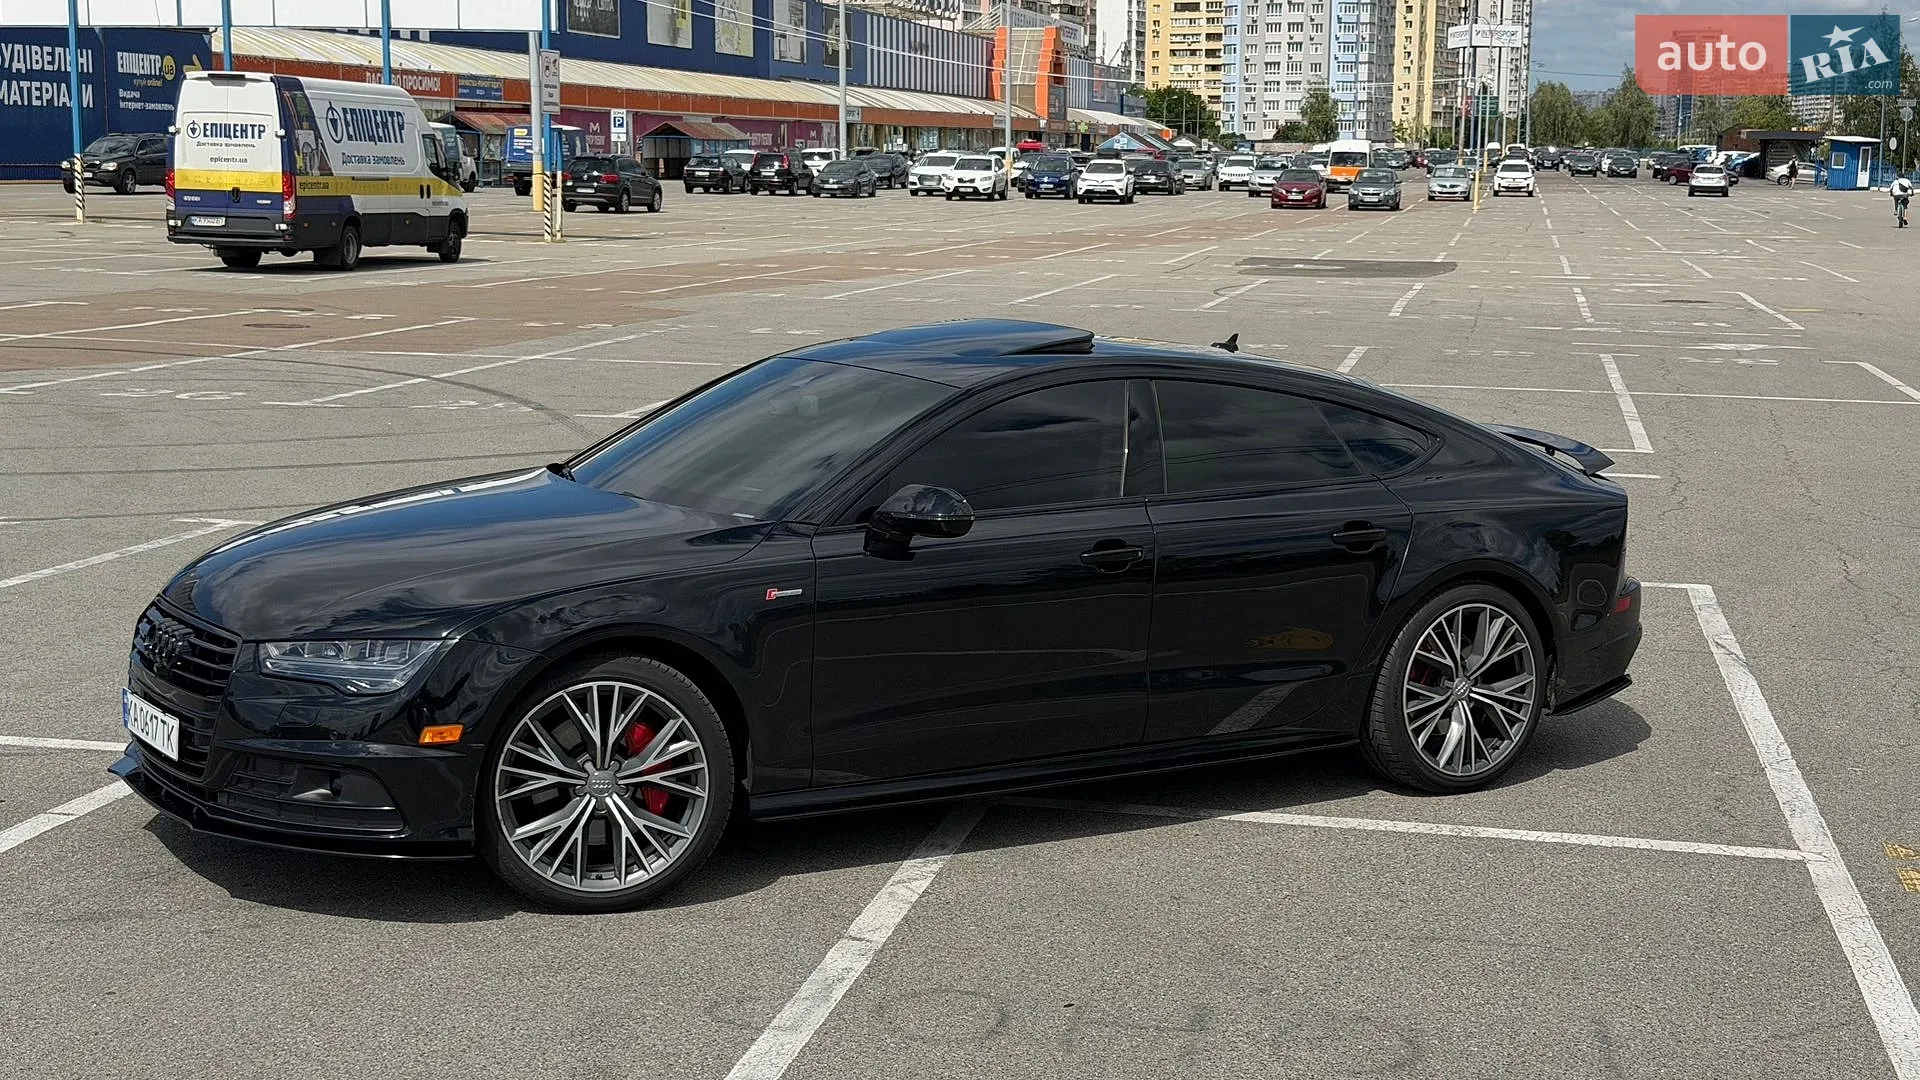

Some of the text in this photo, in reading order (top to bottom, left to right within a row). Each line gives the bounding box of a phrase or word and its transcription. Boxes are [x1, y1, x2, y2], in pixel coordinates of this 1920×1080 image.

[0, 43, 93, 73] УДІВЕЛЬНІ
[0, 80, 93, 108] МАТЕРІАИ
[202, 122, 267, 140] ЕПІЦЕНТР
[341, 107, 405, 145] ЕПІЦЕНТР
[209, 156, 248, 164] epicentr.ua
[341, 152, 406, 166] Доставка замовлень
[299, 181, 329, 192] epicentr.ua
